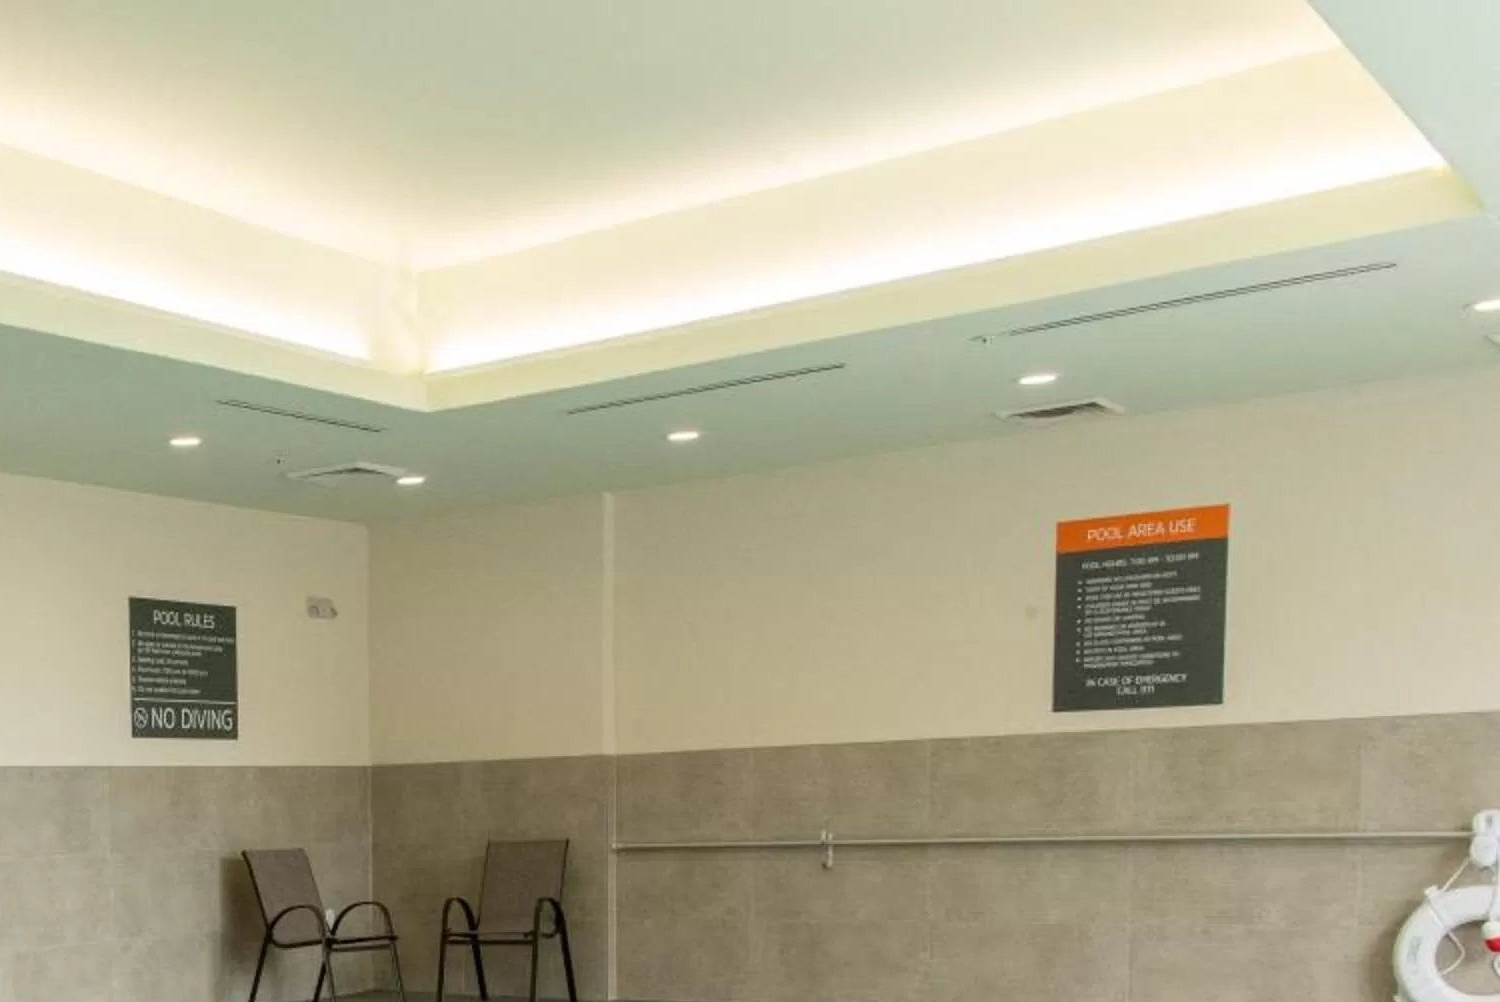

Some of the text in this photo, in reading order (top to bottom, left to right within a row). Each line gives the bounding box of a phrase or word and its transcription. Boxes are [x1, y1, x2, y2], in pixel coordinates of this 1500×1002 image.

[1087, 518, 1197, 543] POOL AREA USE
[153, 609, 215, 629] POOL RULES
[151, 707, 233, 731] NO DIVING
